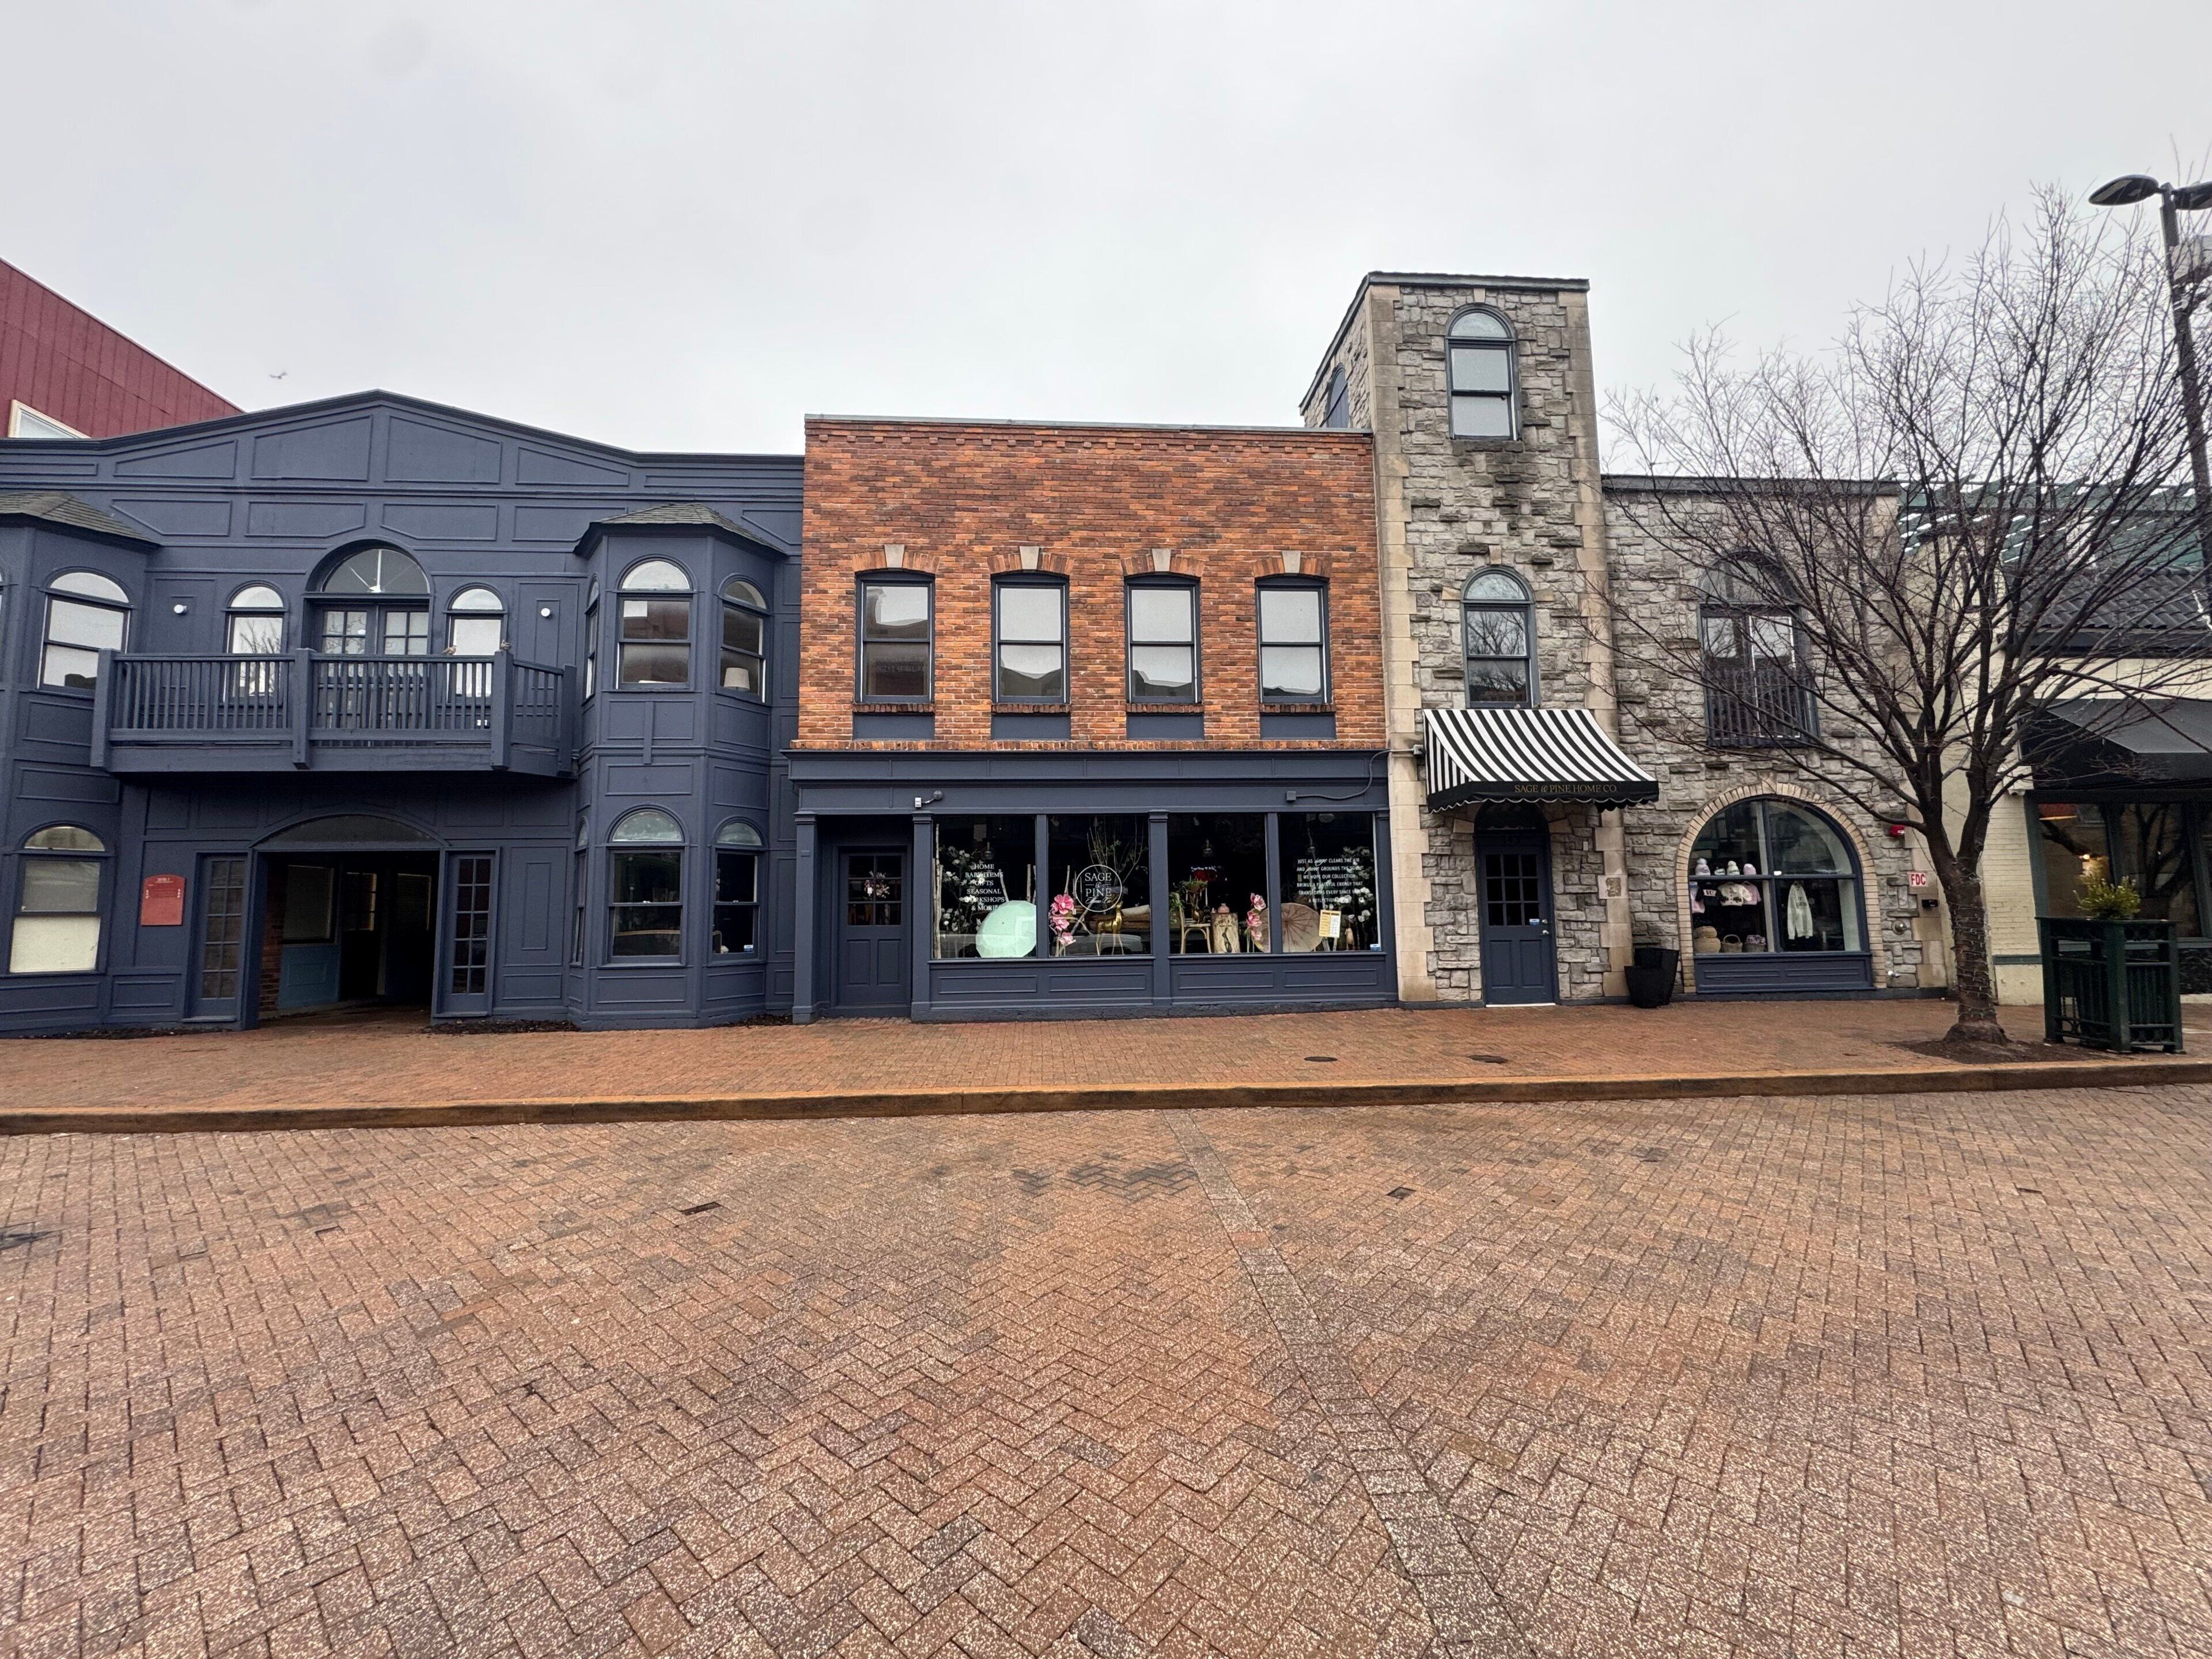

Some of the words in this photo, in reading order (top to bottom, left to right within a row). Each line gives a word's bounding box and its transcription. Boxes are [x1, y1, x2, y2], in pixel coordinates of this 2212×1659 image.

[1514, 785, 1538, 793] SAGE
[1540, 785, 1548, 793] &
[1550, 784, 1571, 793] PINE
[1573, 784, 1601, 793] HOME
[1085, 873, 1112, 881] SAGE
[1911, 874, 1926, 885] FDC
[1085, 888, 1112, 897] PINE
